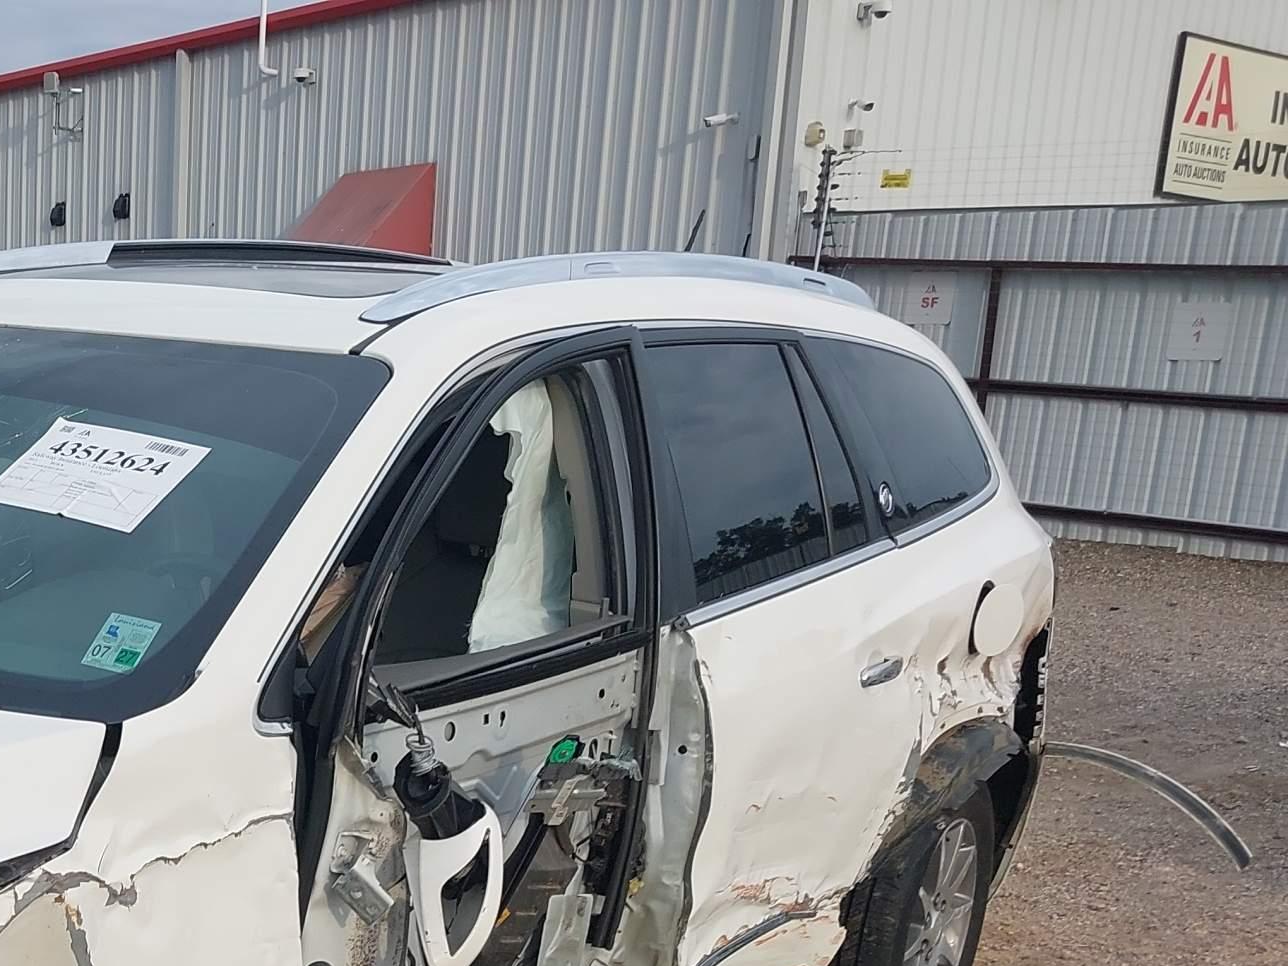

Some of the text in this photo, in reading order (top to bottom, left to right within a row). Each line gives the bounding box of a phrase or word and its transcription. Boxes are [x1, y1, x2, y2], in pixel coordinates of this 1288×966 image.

[1177, 139, 1232, 160] INSURANCE
[1173, 163, 1226, 183] AUTO AUCTIONS
[921, 297, 940, 308] SF
[49, 440, 171, 476] 43512624
[92, 644, 111, 658] 07
